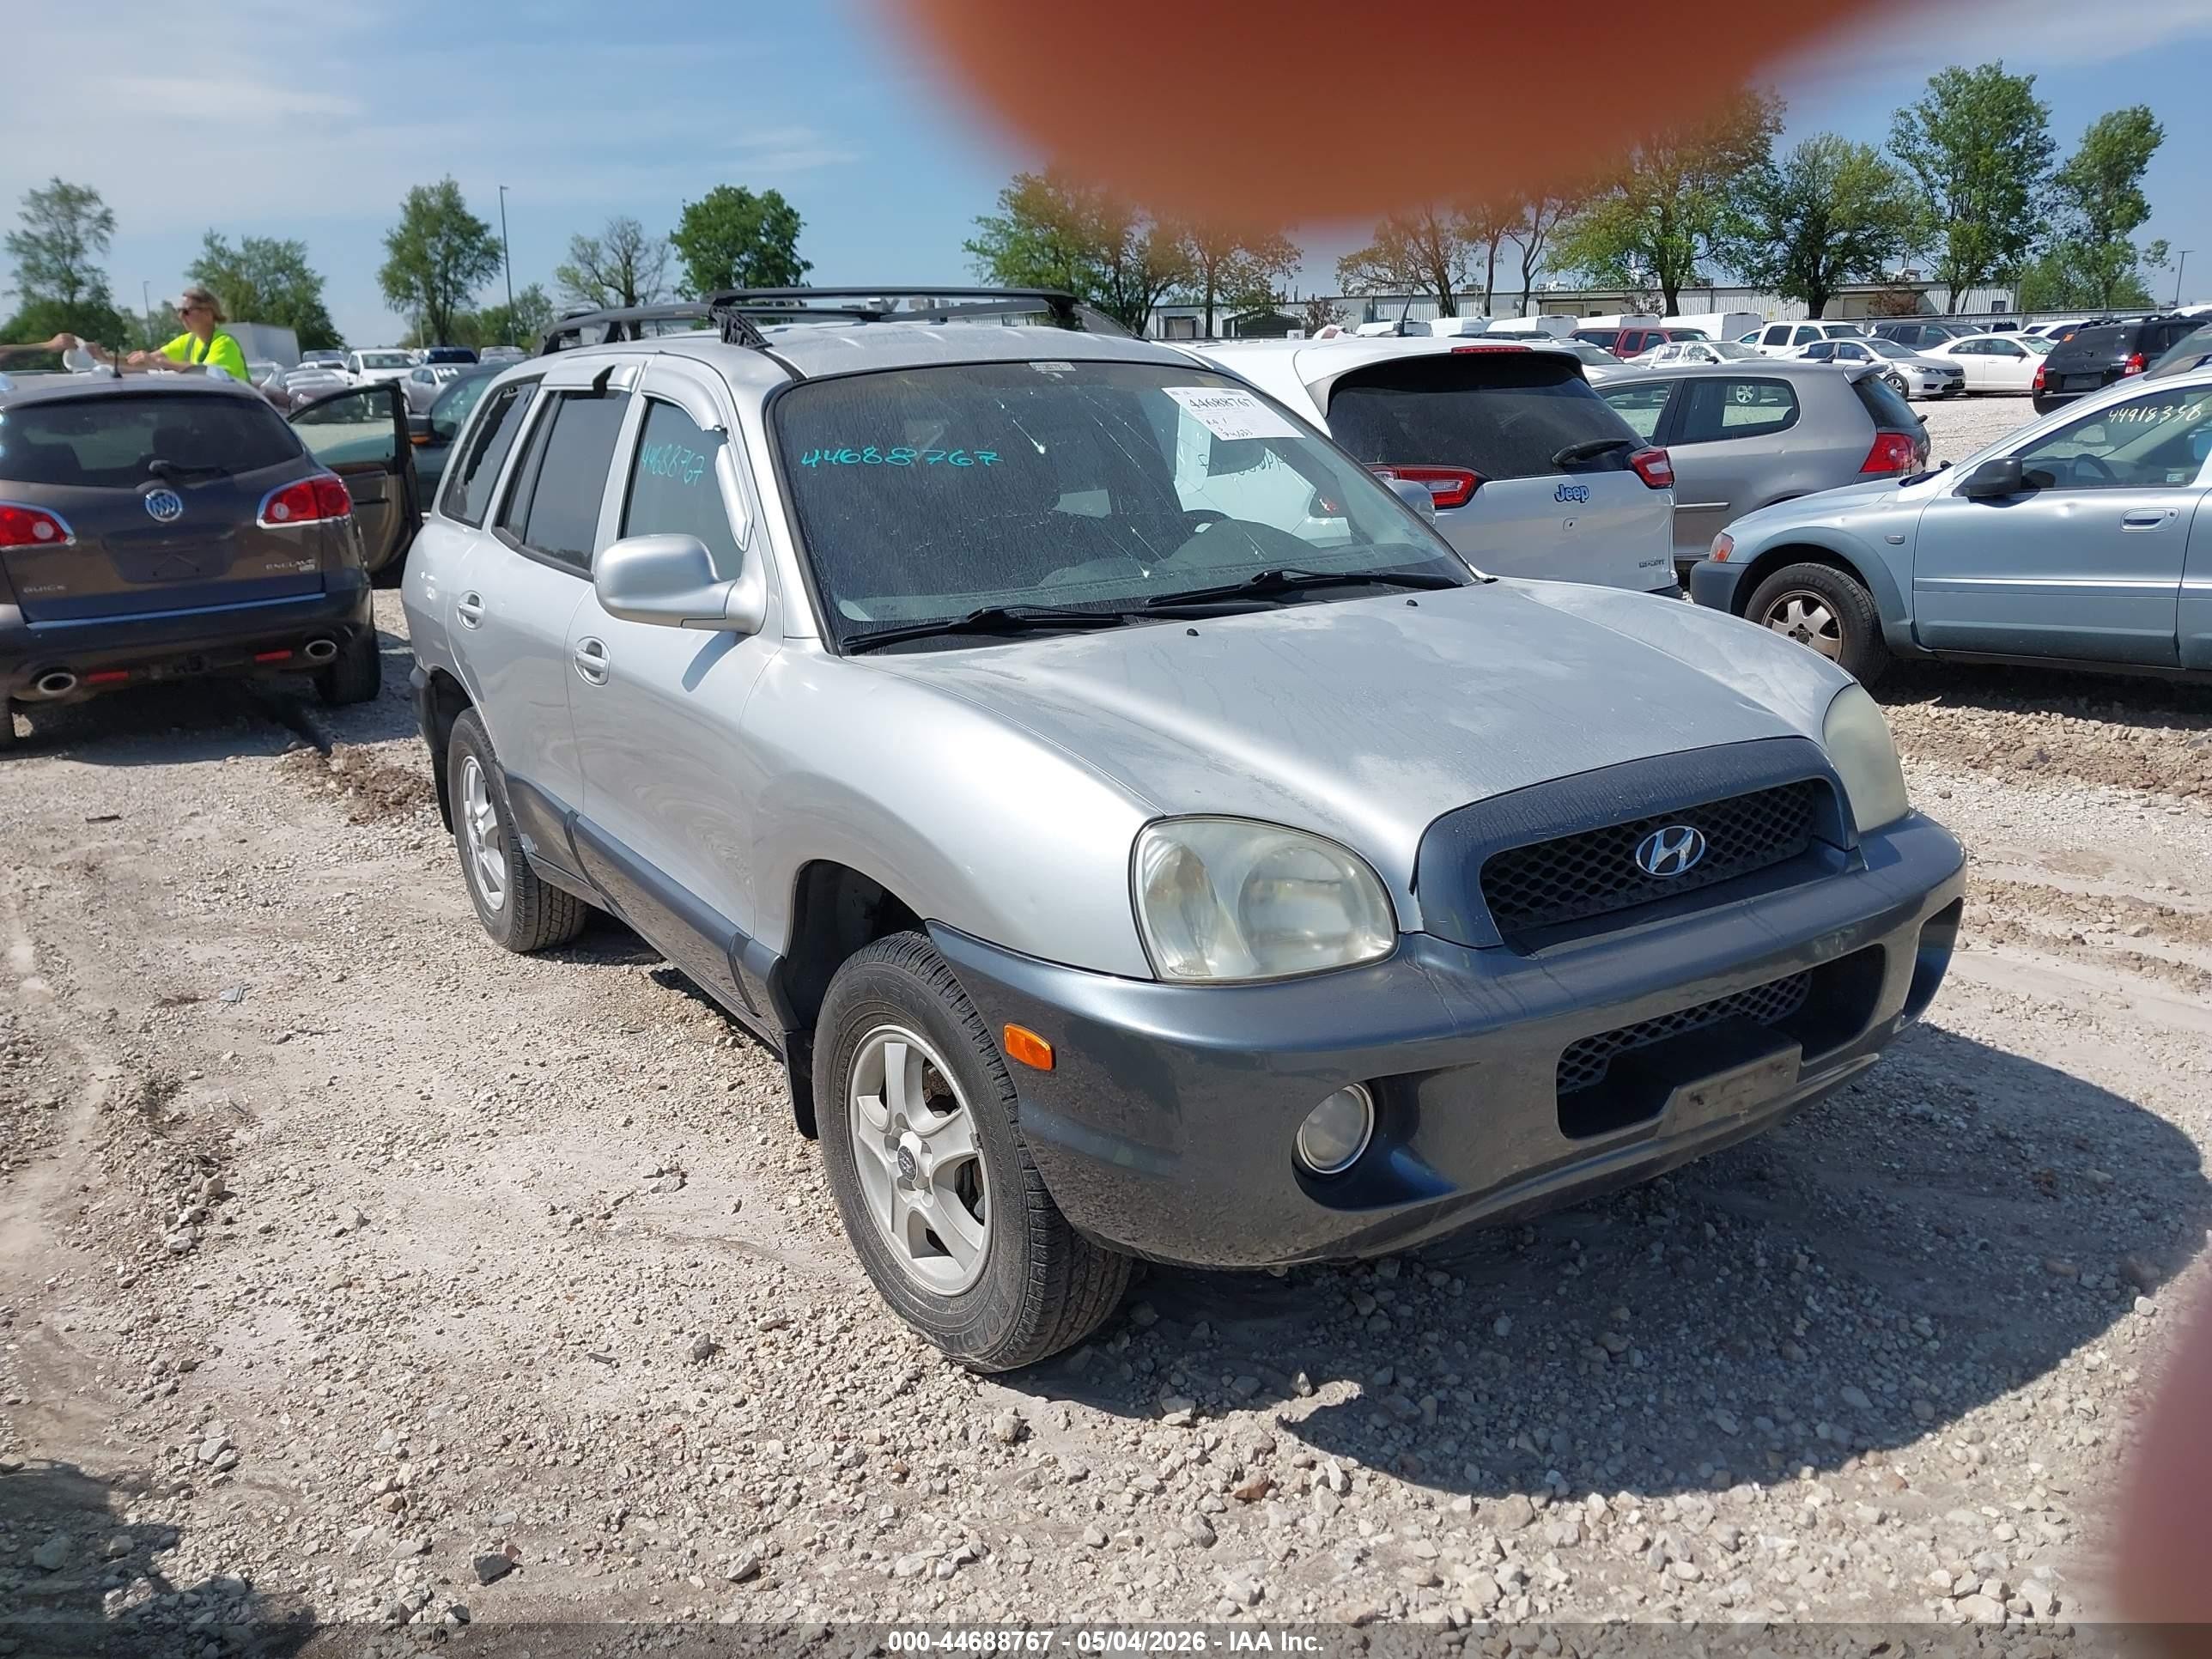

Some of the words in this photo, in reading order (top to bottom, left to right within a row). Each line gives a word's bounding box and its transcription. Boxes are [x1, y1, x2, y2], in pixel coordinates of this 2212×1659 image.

[1188, 398, 1255, 410] 44688767
[2109, 403, 2203, 423] 44918358
[800, 445, 1004, 468] 44688767
[1554, 483, 1589, 503] Jeep
